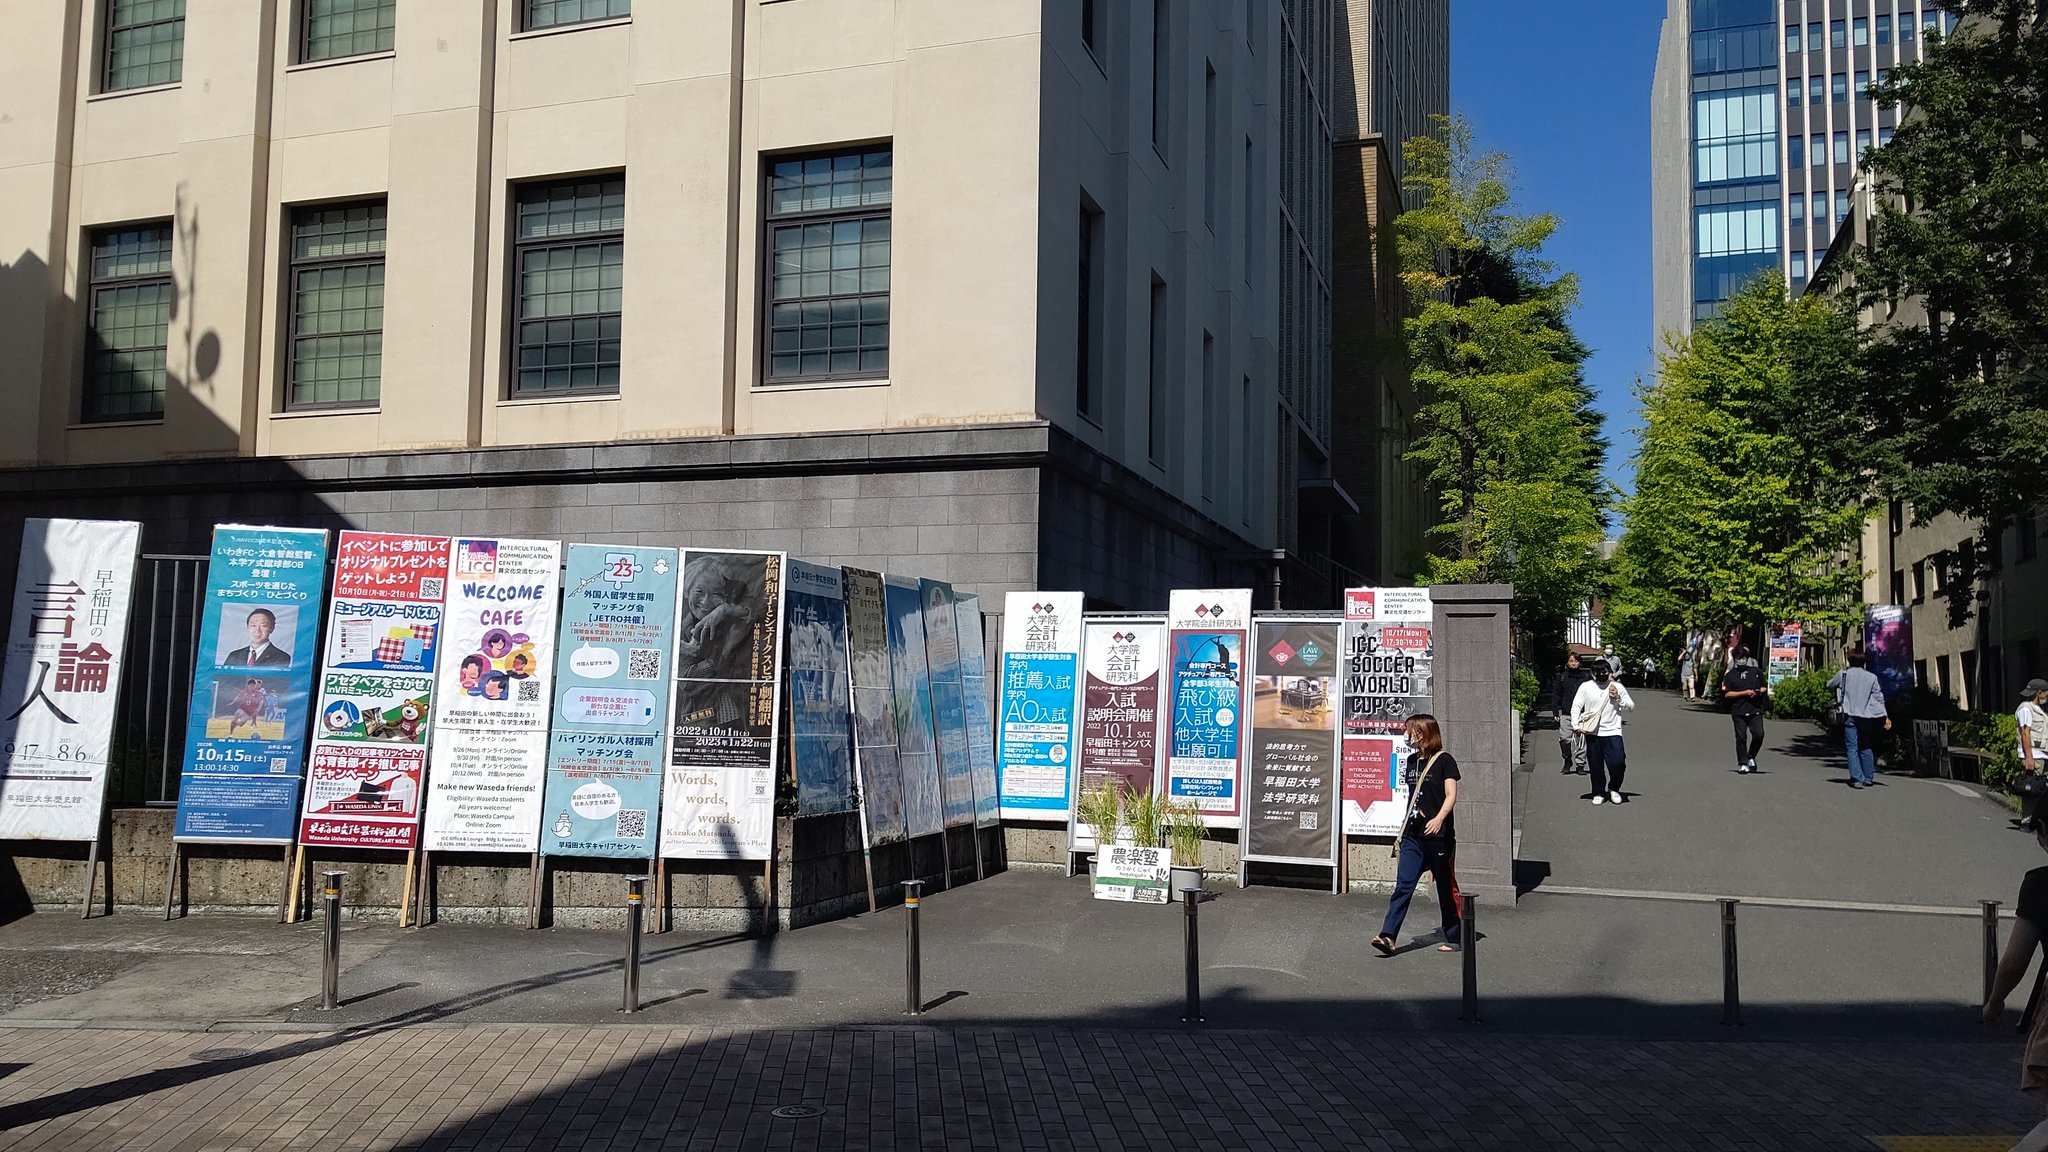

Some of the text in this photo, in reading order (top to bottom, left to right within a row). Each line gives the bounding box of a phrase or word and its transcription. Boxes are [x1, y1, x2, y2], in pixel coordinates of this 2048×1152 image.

[342, 540, 448, 553] イベントに参加して
[228, 558, 304, 569] 本学ア式蹴球部OB
[340, 555, 448, 569] オリジナルプレゼントを
[469, 561, 492, 572] ICC
[613, 563, 632, 577] 23
[339, 571, 415, 585] ゲットしよう！
[230, 580, 297, 590] スポーツを通じた
[217, 589, 307, 600] まちづくり・ひとづくり
[463, 582, 545, 602] WELCOME
[584, 590, 654, 602] 外国人留学生採用
[89, 569, 114, 637] 早稲田の
[592, 603, 645, 612] マッチング会
[335, 601, 440, 619] ミュージアムワードパズル
[480, 609, 523, 626] CAFE
[1027, 615, 1058, 625] 大学院
[1176, 619, 1241, 628] 大学院会計研究科
[1026, 625, 1058, 641] 会計
[758, 555, 779, 726] 松岡和子とシェイクスピア劇翻訳
[1025, 641, 1057, 652] 研究科
[1352, 636, 1377, 653] ICC
[1107, 645, 1140, 655] 大学院
[1009, 661, 1028, 671] 学内
[1106, 655, 1141, 671] 会計
[1352, 656, 1415, 673] SOCCER
[326, 673, 432, 691] ワセダベアをさがせ！
[1008, 671, 1071, 690] 推薦入試
[1106, 671, 1139, 682] 研究科
[1352, 676, 1409, 693] WORLD
[326, 686, 394, 697] inVRミュージアム
[1007, 690, 1026, 700] 学内
[1179, 688, 1236, 707] 飛び級
[1105, 692, 1137, 708] 入試
[1352, 696, 1382, 714] CUP
[1005, 700, 1066, 723] AO入試
[1087, 708, 1154, 723] 説明会開催
[1175, 708, 1213, 726] 入試
[558, 735, 654, 746] バイリンガル人材採用
[1175, 727, 1234, 743] 他大学生
[1086, 738, 1152, 748] 早稲田キャンパス
[1265, 743, 1307, 751] 法的思考力で
[316, 746, 424, 758] お気に入りの記事をリツイート！
[577, 748, 634, 758] マッチング会
[1177, 743, 1228, 758] 出願可！
[1265, 753, 1319, 761] グローバル社会の
[314, 756, 420, 771] 体育各部イチ推し記事
[1265, 763, 1311, 772] 未来に貢献する
[313, 768, 379, 780] キャンペーン
[672, 772, 717, 787] Words,
[507, 784, 536, 792] friends!
[1263, 776, 1321, 788] 早稲田大学
[686, 793, 729, 807] words,
[1262, 792, 1320, 805] 法学研究科
[698, 812, 740, 824] words.
[331, 835, 358, 843] University
[667, 829, 736, 837] Kazuko Matsuoka
[558, 842, 642, 850] 早稲田大学キャリアセンター
[751, 840, 767, 848] Plays
[1111, 848, 1159, 866] 農楽塾
